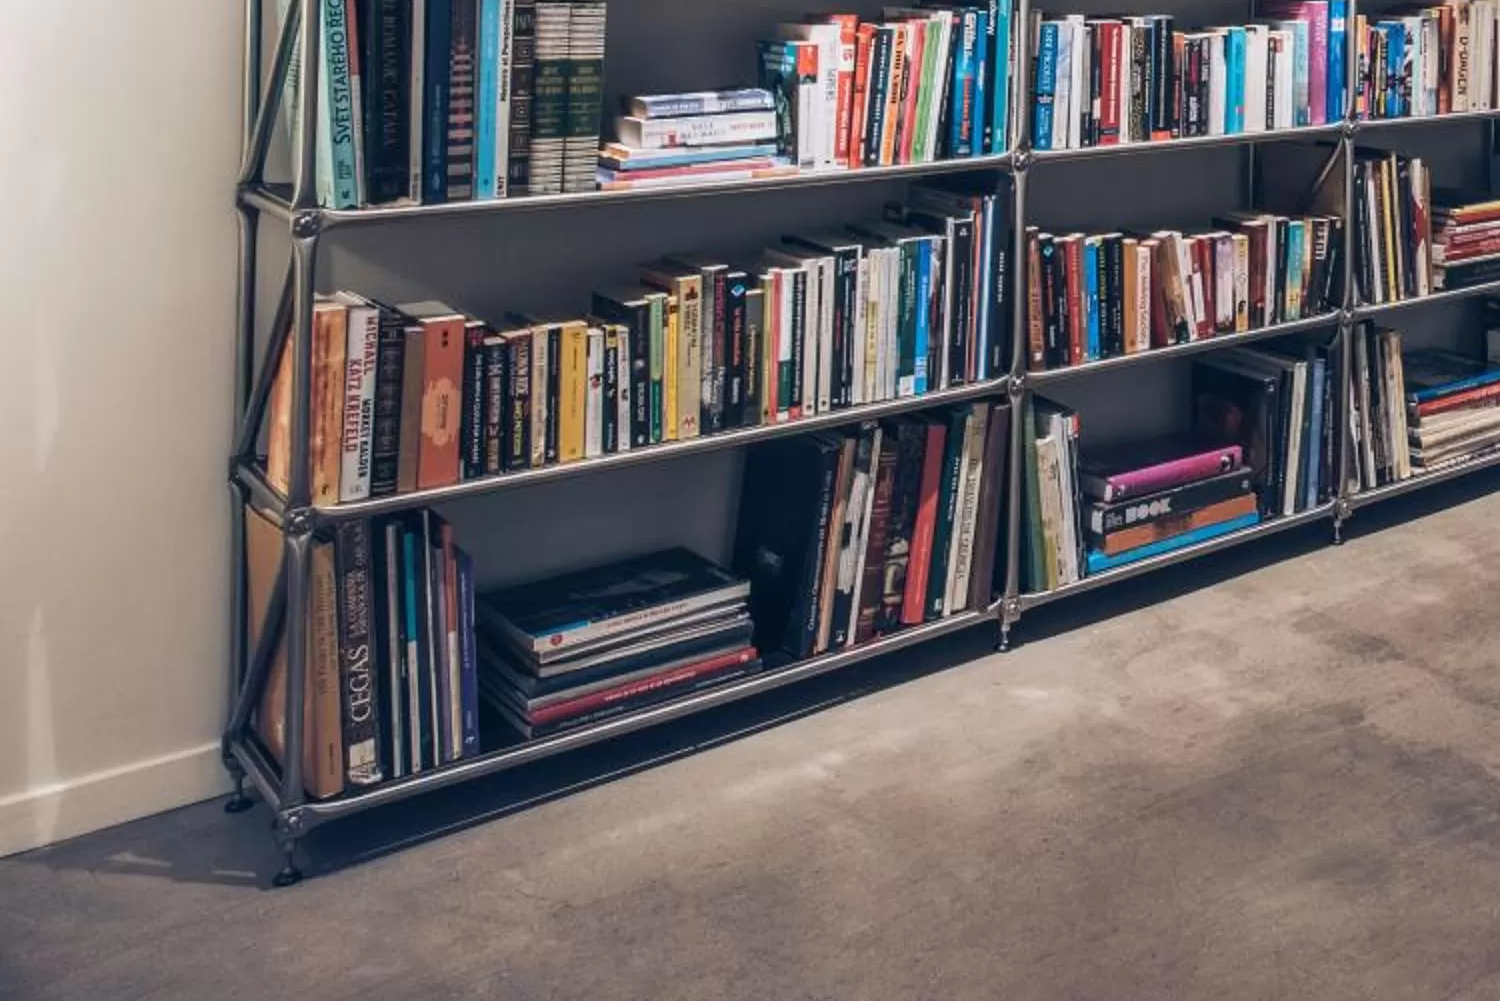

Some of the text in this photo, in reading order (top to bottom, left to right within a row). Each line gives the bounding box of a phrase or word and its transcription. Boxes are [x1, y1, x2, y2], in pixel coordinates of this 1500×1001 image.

[328, 32, 349, 102] STARÉHO
[332, 106, 351, 145] SVĚT
[345, 359, 363, 453] KATZ KREFELD
[347, 644, 372, 722] CEGAS
